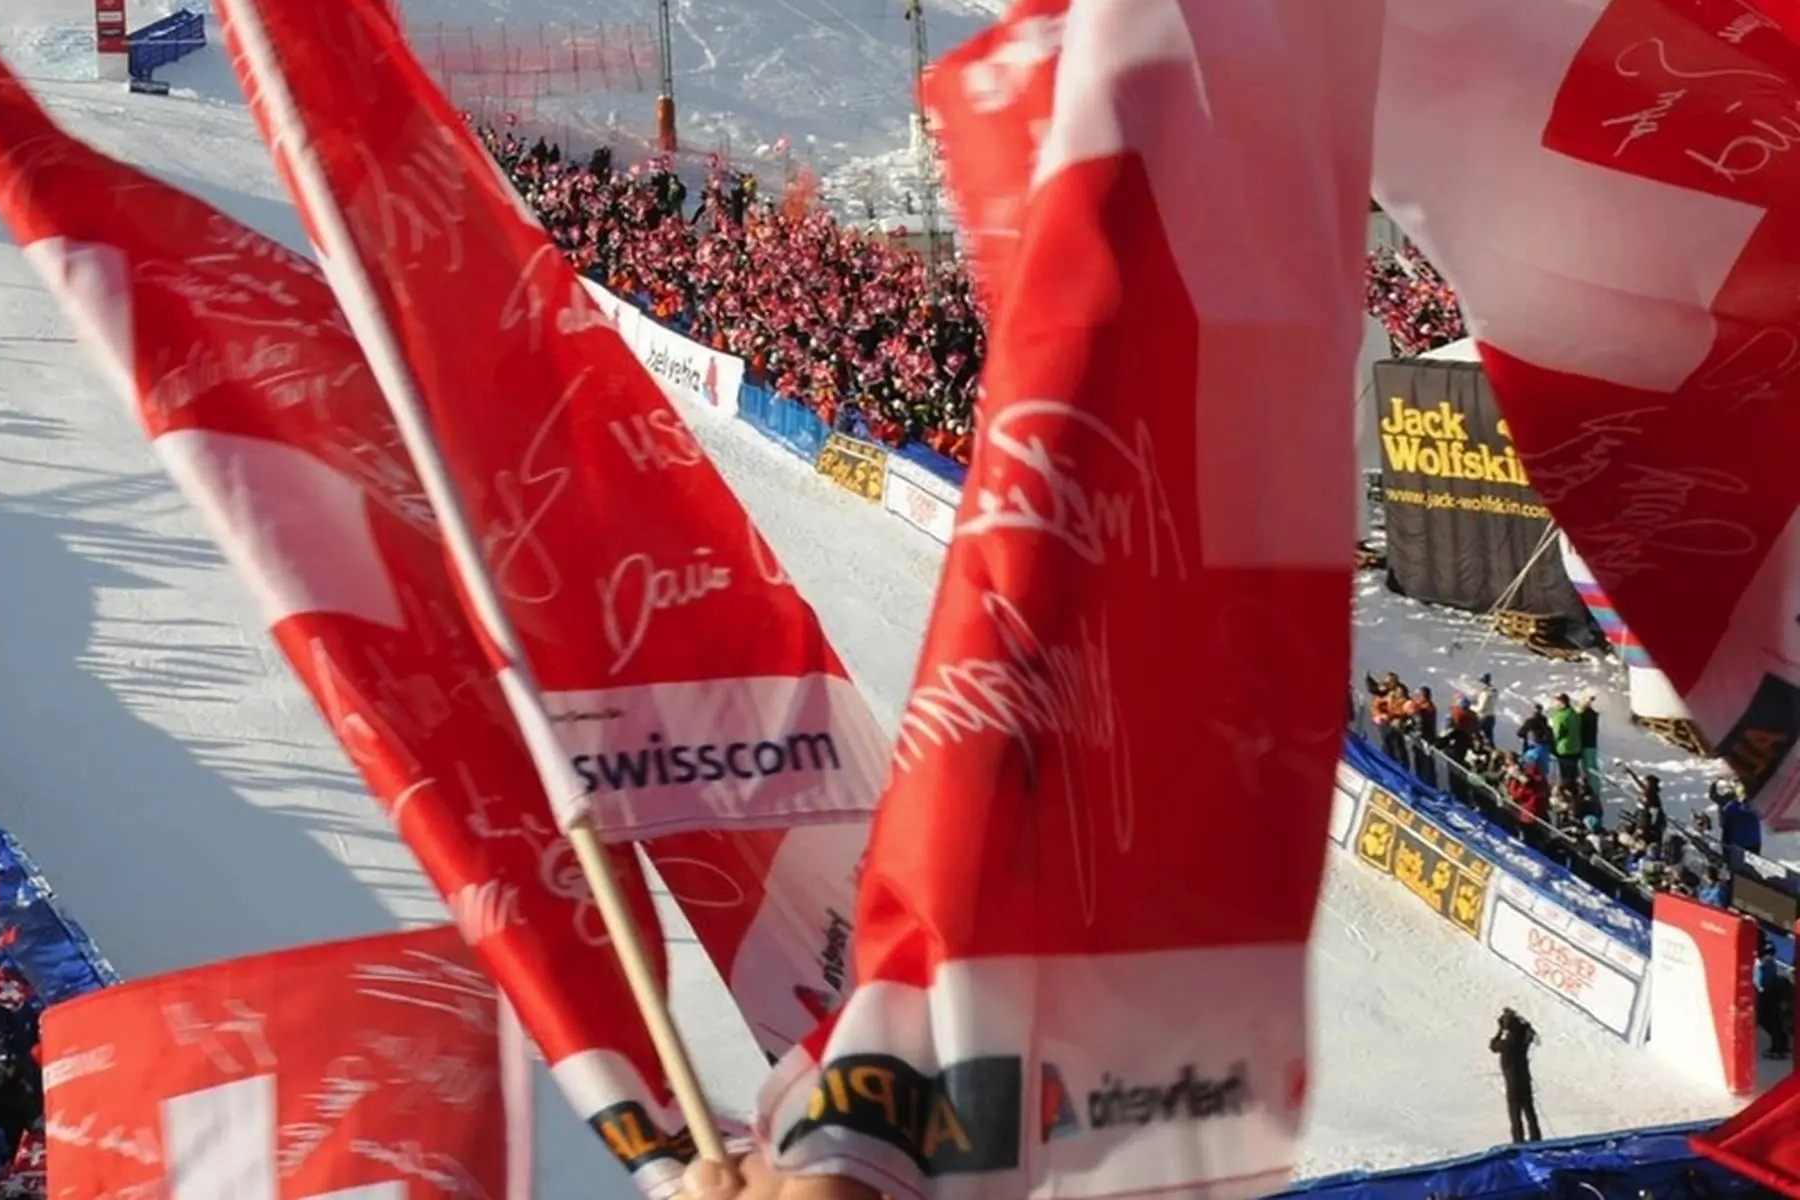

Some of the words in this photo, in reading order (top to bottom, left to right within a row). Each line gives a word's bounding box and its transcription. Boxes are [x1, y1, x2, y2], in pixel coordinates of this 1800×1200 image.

[647, 339, 700, 392] helvetia
[1381, 397, 1468, 441] Jack
[572, 731, 842, 794] swisscom
